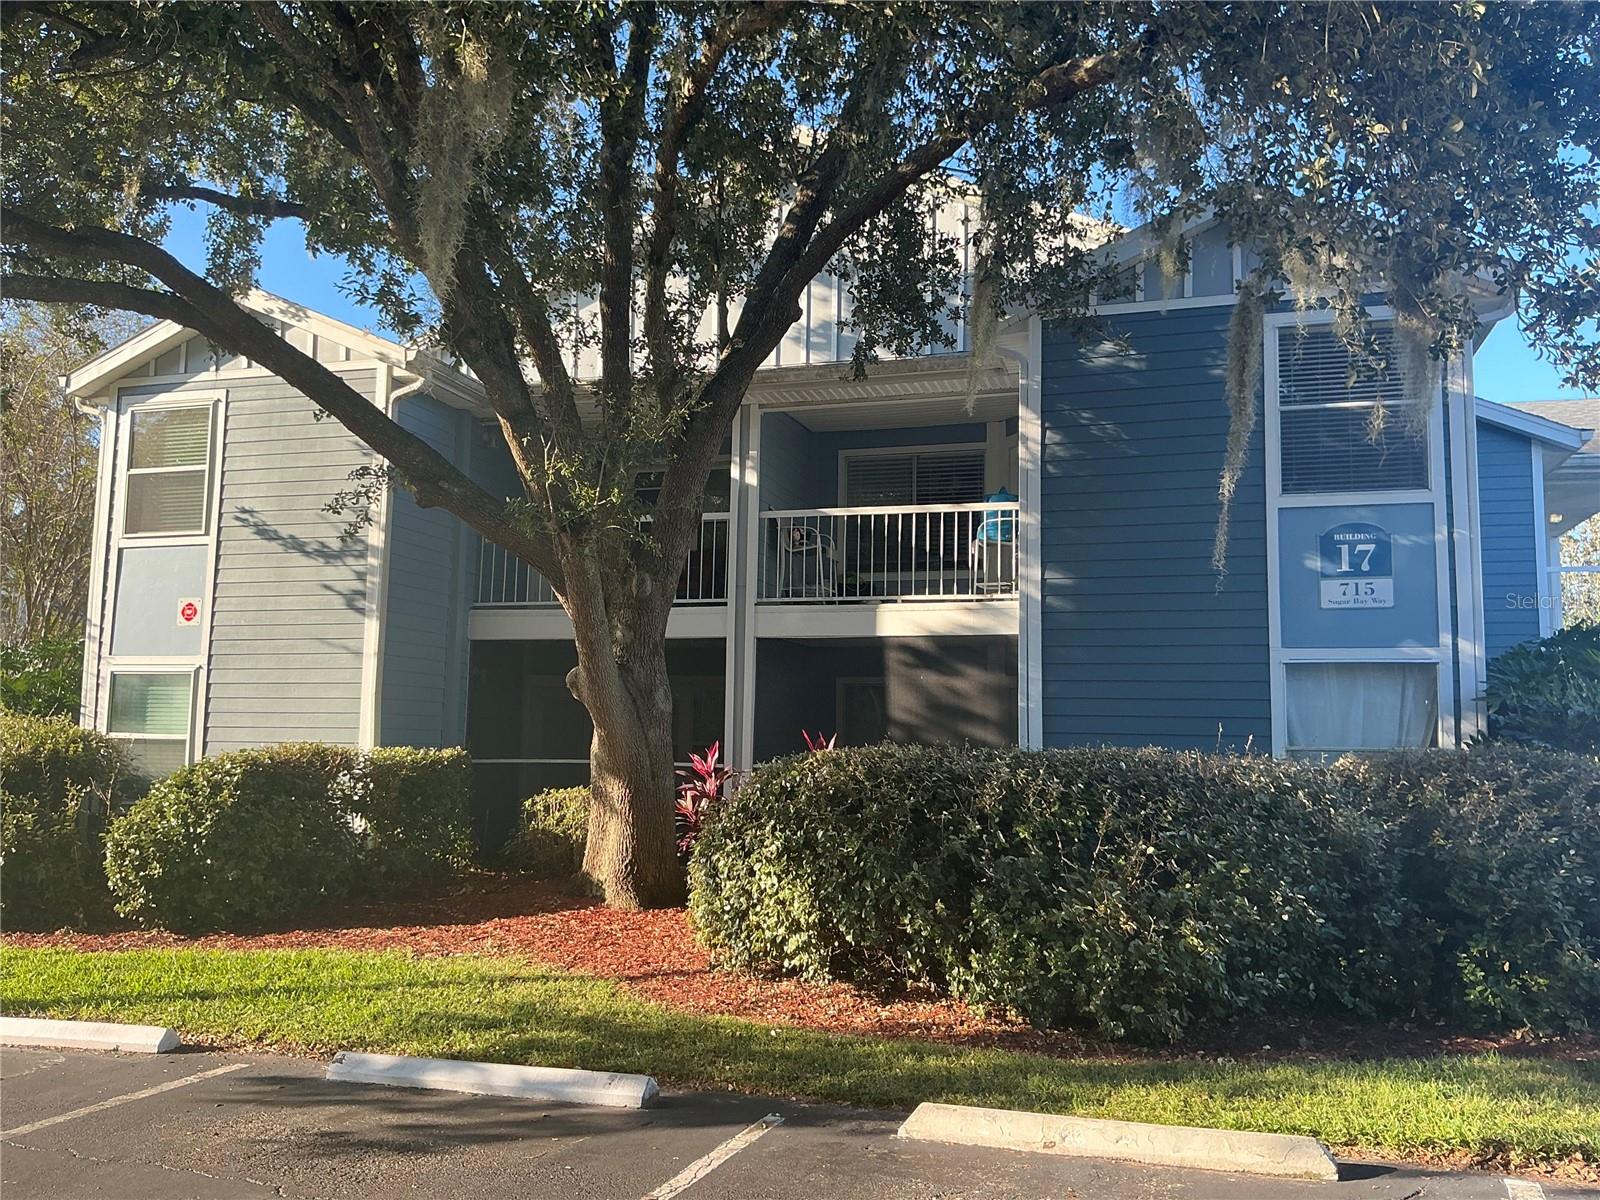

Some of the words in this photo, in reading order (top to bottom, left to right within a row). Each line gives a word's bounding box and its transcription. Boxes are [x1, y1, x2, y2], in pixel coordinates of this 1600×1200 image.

[1333, 532, 1377, 541] BUILDING
[1335, 544, 1376, 572] 17
[1338, 581, 1376, 597] 715
[1327, 598, 1351, 606] Sugar
[1371, 597, 1387, 606] Way
